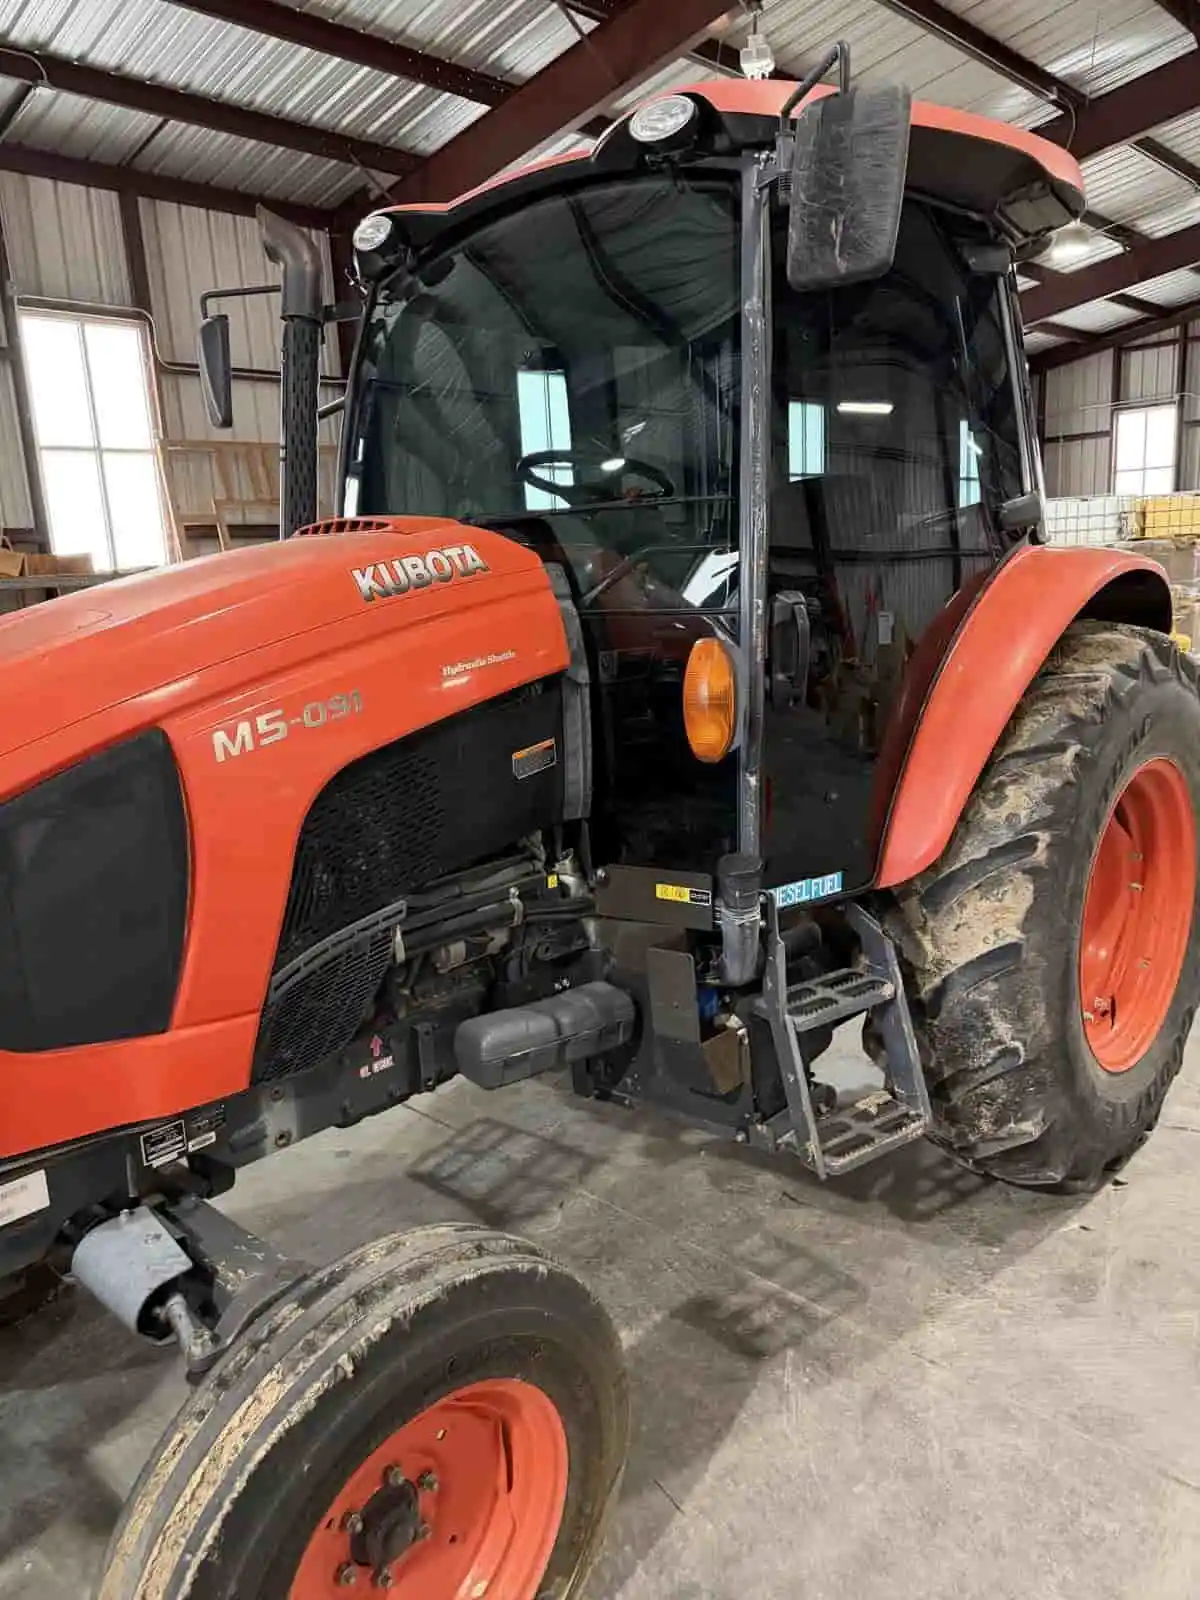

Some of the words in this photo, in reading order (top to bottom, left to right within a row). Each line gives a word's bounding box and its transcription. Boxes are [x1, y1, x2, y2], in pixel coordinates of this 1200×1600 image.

[351, 544, 491, 602] KUBOTA
[212, 690, 362, 763] M5-091
[812, 871, 842, 899] FUEL
